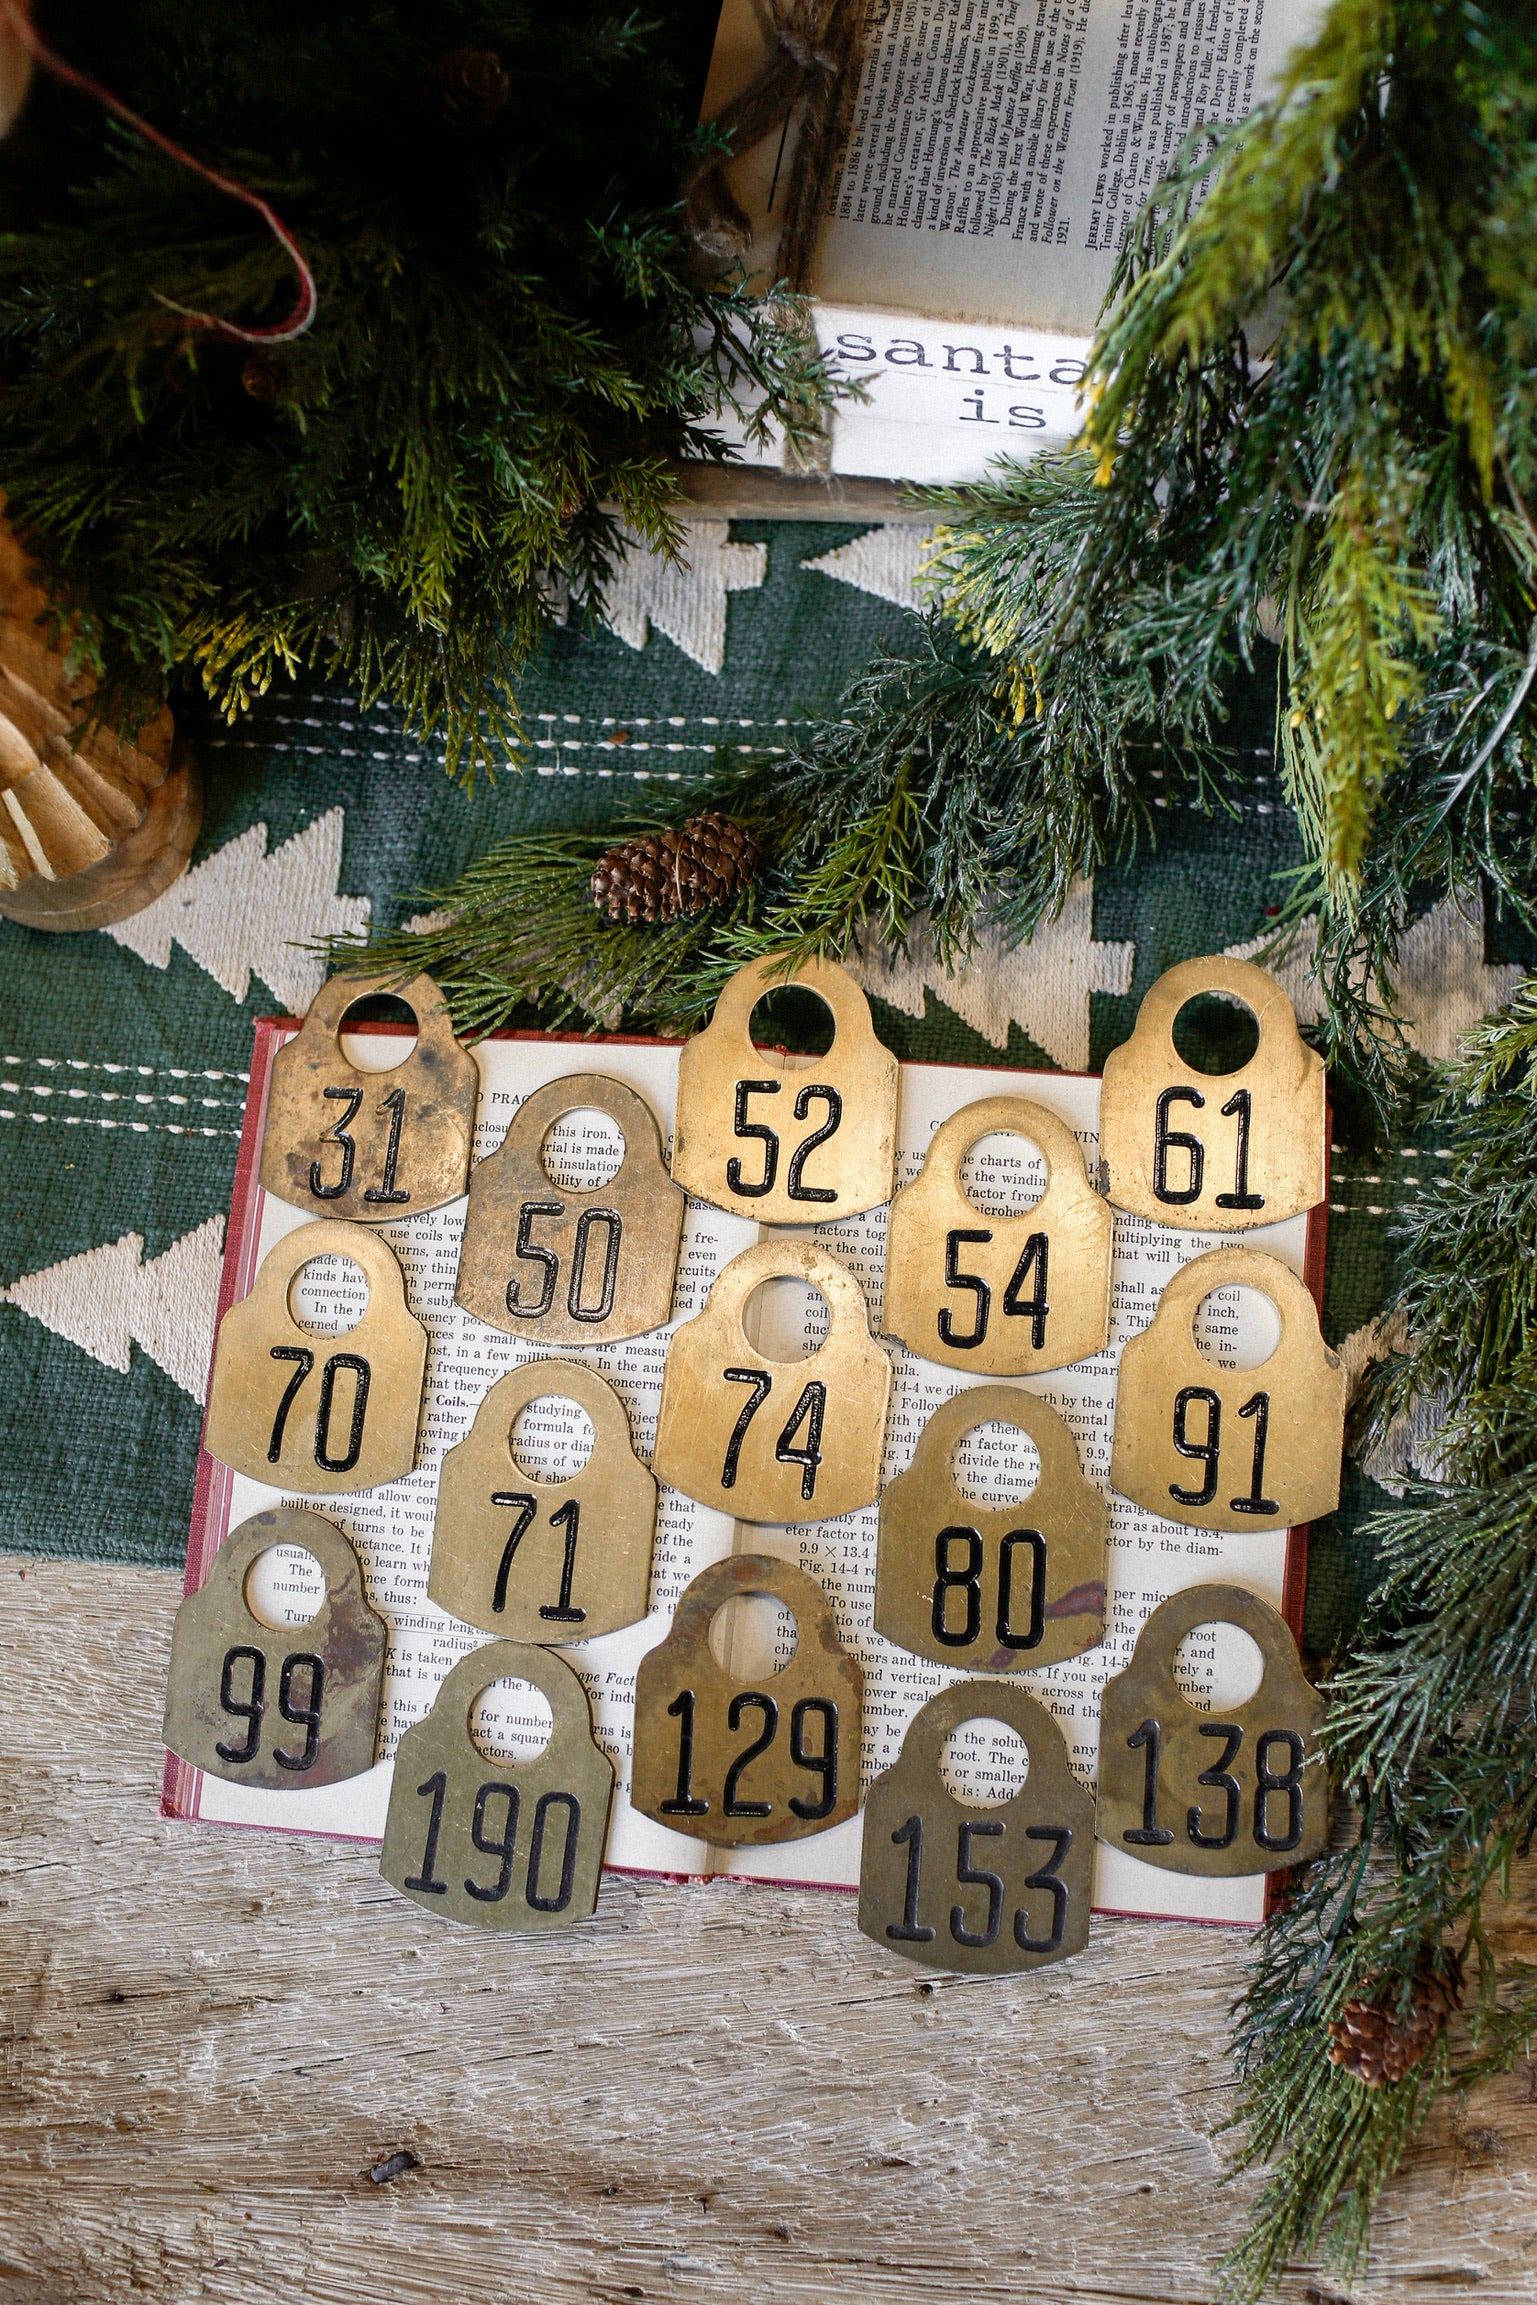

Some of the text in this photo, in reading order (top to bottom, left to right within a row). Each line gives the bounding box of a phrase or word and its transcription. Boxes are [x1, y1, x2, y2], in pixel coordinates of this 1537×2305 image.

[940, 18, 957, 65] character
[1116, 22, 1130, 49] after
[952, 33, 971, 75] Holmes,
[1175, 2, 1206, 128] introductions to reissues
[1108, 52, 1127, 109] publishing
[944, 76, 962, 120] Sherlock
[1138, 23, 1175, 186] Time, was published in 1987;
[881, 5, 932, 226] he married Constance Doyle, the sister of
[953, 12, 1004, 234] Raffles to an appreciative public in 1899,
[1104, 113, 1116, 124] in
[942, 120, 954, 133] of
[982, 24, 1030, 238] Night (1905) and Mr Justice Raffles (1909).
[997, 29, 1044, 226] During the First World War, Hornung
[1098, 6, 1149, 251] Trinity College, Dublin in 1965, most recently
[1028, 33, 1070, 243] and wrote of these experiences in Notes
[1100, 128, 1114, 169] worked
[933, 135, 951, 182] inversion
[918, 165, 932, 187] that
[931, 182, 943, 196] of
[910, 189, 927, 229] claimed
[925, 196, 941, 221] kind
[1056, 216, 1070, 245] 1921.
[836, 333, 1087, 384] santa
[959, 389, 1047, 428] is
[552, 1126, 610, 1140] this iron.
[309, 1086, 410, 1204] 31
[726, 1080, 843, 1203] 52
[1153, 1085, 1265, 1209] 61
[586, 1144, 619, 1156] made
[980, 1155, 1042, 1169] charts of
[975, 1171, 996, 1183] the
[966, 1186, 1006, 1200] factor
[390, 1230, 443, 1242] use coils
[814, 1225, 859, 1238] factors
[836, 1242, 887, 1256] the coil.
[1191, 1238, 1212, 1249] the
[506, 1201, 622, 1323] 50
[688, 1251, 716, 1260] even
[1146, 1250, 1170, 1263] will
[303, 1269, 337, 1282] kinds
[302, 1286, 366, 1300] connection
[938, 1229, 1049, 1349] 54
[1114, 1281, 1145, 1294] shall
[1218, 1290, 1240, 1302] coil
[314, 1302, 352, 1316] In the
[1208, 1305, 1239, 1319] inch,
[1205, 1324, 1238, 1335] same
[462, 1332, 517, 1346] so small
[1219, 1341, 1238, 1352] in-
[487, 1348, 510, 1360] few
[436, 1361, 499, 1378] frequency
[454, 1380, 481, 1394] they
[893, 1381, 920, 1393] 14-4
[267, 1346, 371, 1472] 70
[526, 1404, 582, 1419] studying
[427, 1411, 468, 1424] rather
[524, 1419, 574, 1434] formula
[721, 1368, 826, 1500] 74
[991, 1423, 1020, 1436] then
[510, 1436, 567, 1450] radius or
[978, 1439, 1018, 1452] factor
[1169, 1386, 1280, 1514] 91
[959, 1454, 1024, 1470] divide the
[378, 1489, 412, 1503] allow
[330, 1502, 386, 1518] designed,
[670, 1502, 696, 1514] that
[352, 1521, 385, 1534] turns
[816, 1527, 857, 1541] factor
[1152, 1523, 1189, 1536] about
[842, 1546, 869, 1559] 13.4
[1139, 1539, 1223, 1556] by the diam-
[375, 1557, 407, 1570] learn
[490, 1492, 586, 1622] 71
[289, 1564, 312, 1577] The
[273, 1581, 320, 1595] number
[932, 1526, 1047, 1649] 80
[384, 1592, 418, 1605] thus:
[1114, 1590, 1136, 1602] per
[394, 1616, 445, 1632] winding
[1189, 1631, 1216, 1642] root
[418, 1655, 453, 1666] taken
[1190, 1647, 1216, 1660] and
[891, 1671, 941, 1686] vertical
[1042, 1688, 1084, 1699] across
[216, 1646, 325, 1771] 99
[660, 1690, 839, 1820] 129
[950, 1750, 1015, 1765] root. The
[975, 1769, 1025, 1784] smaller
[1122, 1718, 1305, 1851] 138
[404, 1771, 581, 1912] 190
[886, 1815, 1072, 1951] 153
